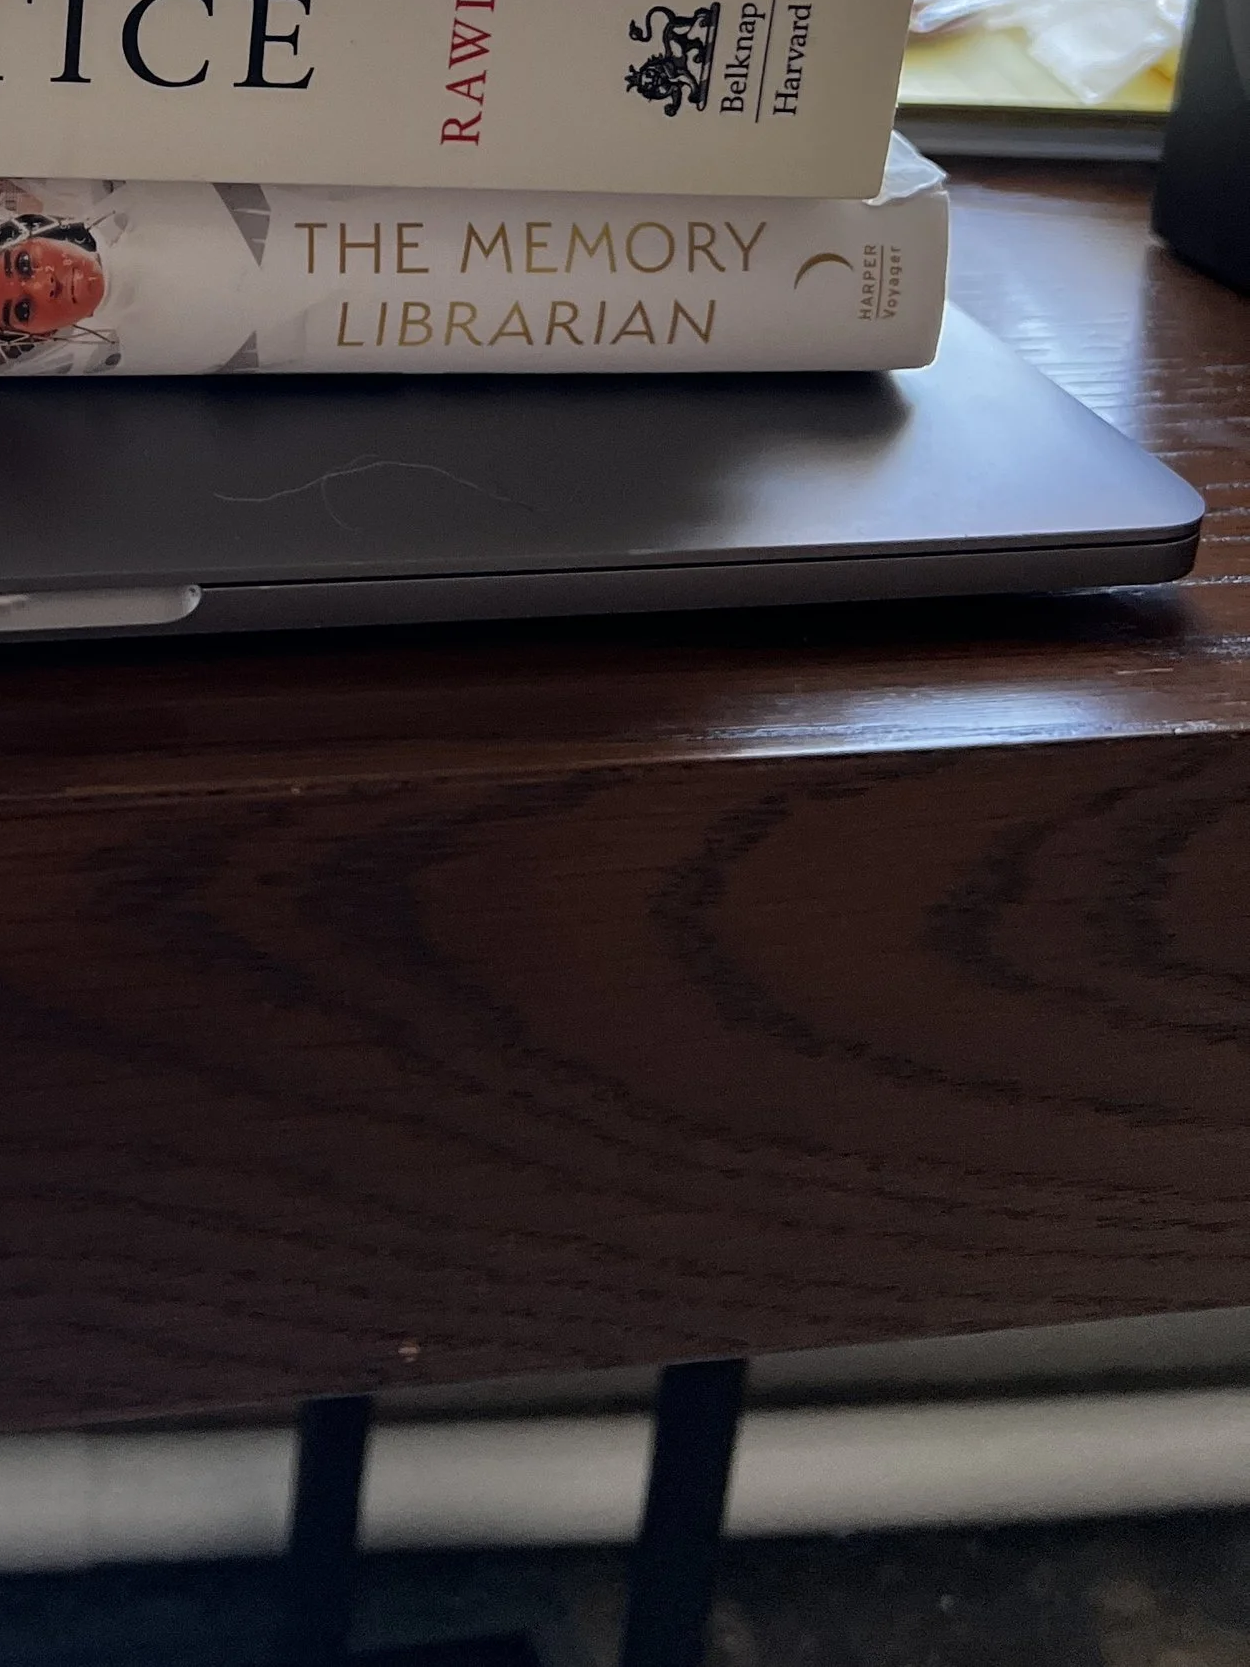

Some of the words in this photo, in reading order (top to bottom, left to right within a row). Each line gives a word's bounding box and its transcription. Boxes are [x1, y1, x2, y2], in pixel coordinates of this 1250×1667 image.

[720, 2, 766, 114] Belknap
[772, 3, 813, 116] Harvard
[295, 222, 430, 274] THE
[460, 221, 767, 274] MEMORY
[858, 243, 877, 321] HARPER
[336, 299, 717, 347] LIBRARIAN
